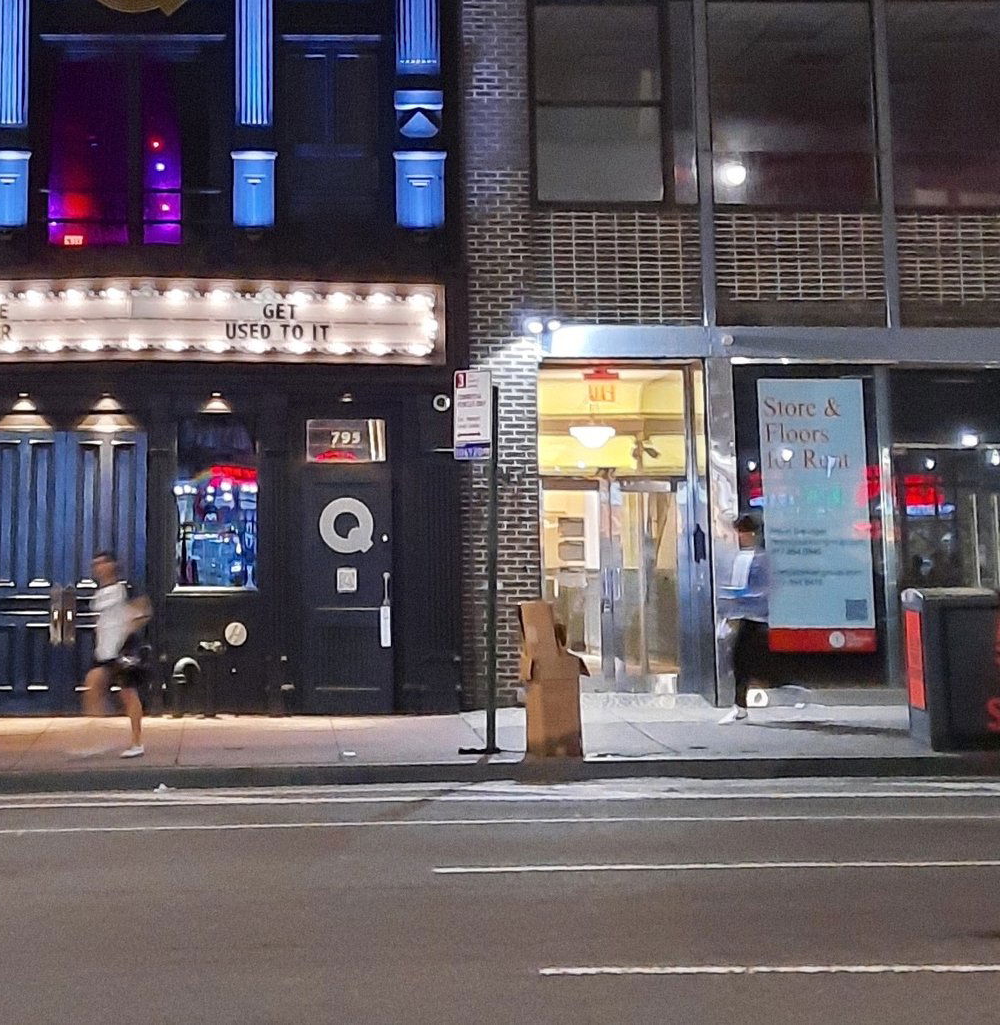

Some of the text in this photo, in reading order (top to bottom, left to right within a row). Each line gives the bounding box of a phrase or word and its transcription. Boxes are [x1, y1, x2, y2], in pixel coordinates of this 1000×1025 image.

[263, 303, 297, 319] GET
[225, 323, 329, 340] USED TO IT
[764, 397, 840, 417] Store &
[766, 423, 829, 443] Floors
[319, 497, 374, 553] Q
